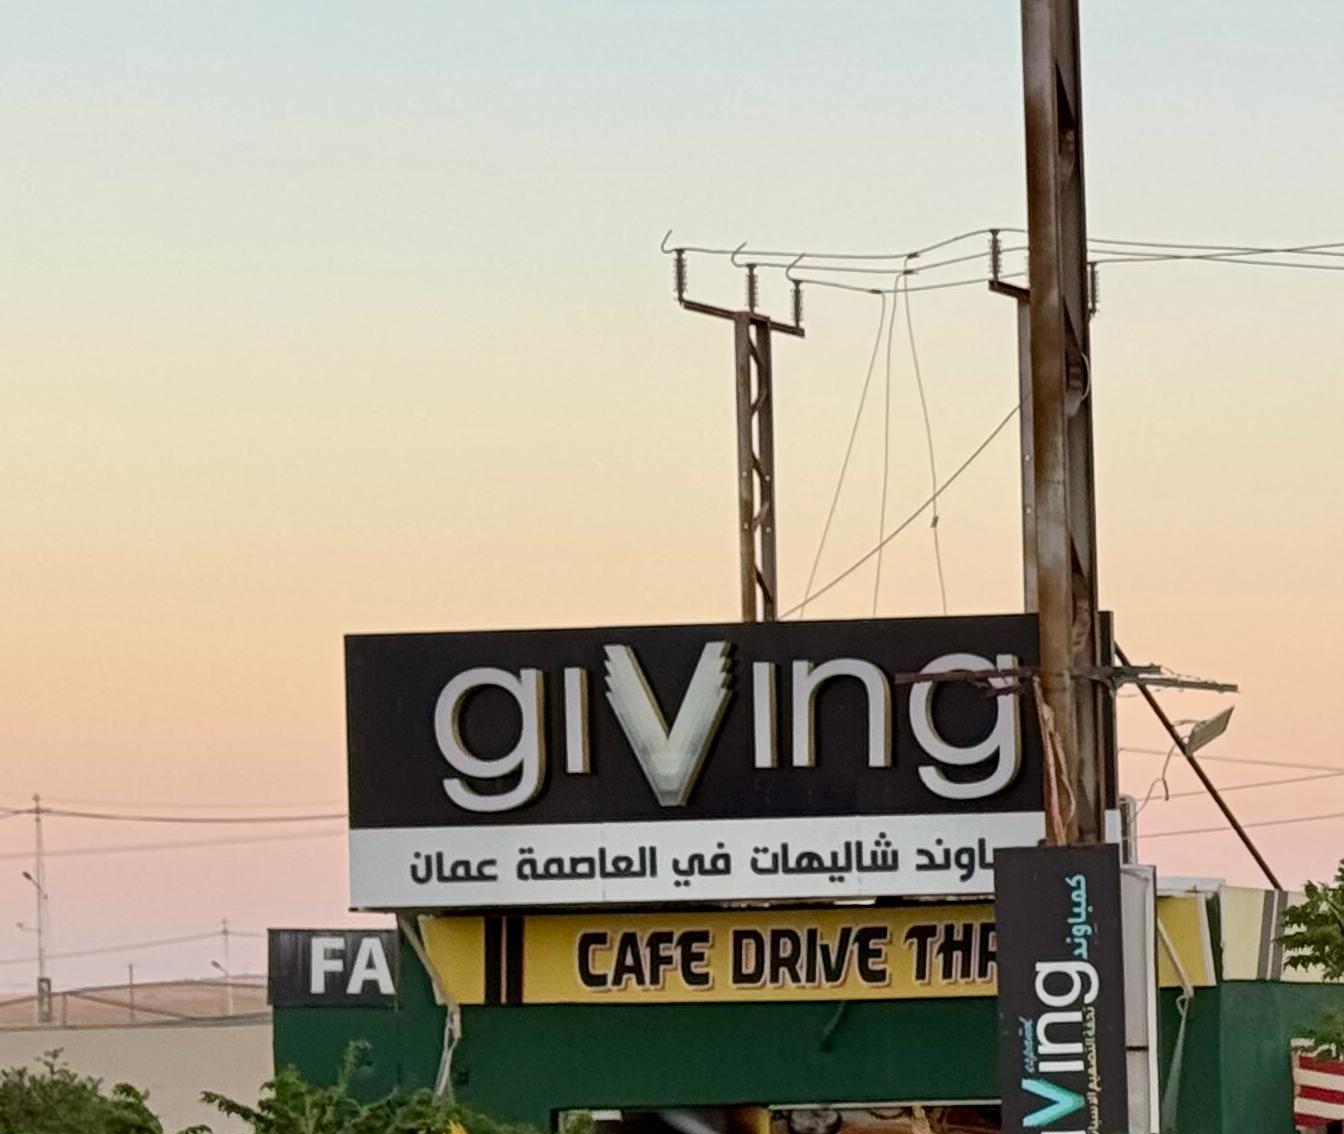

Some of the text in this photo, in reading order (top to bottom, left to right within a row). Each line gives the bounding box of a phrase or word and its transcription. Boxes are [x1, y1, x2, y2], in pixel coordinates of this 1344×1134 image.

[410, 832, 993, 887] اوند شاليهات في العاصمة عمان
[310, 936, 396, 995] FA
[577, 922, 997, 989] CAFE DRIVE THR
